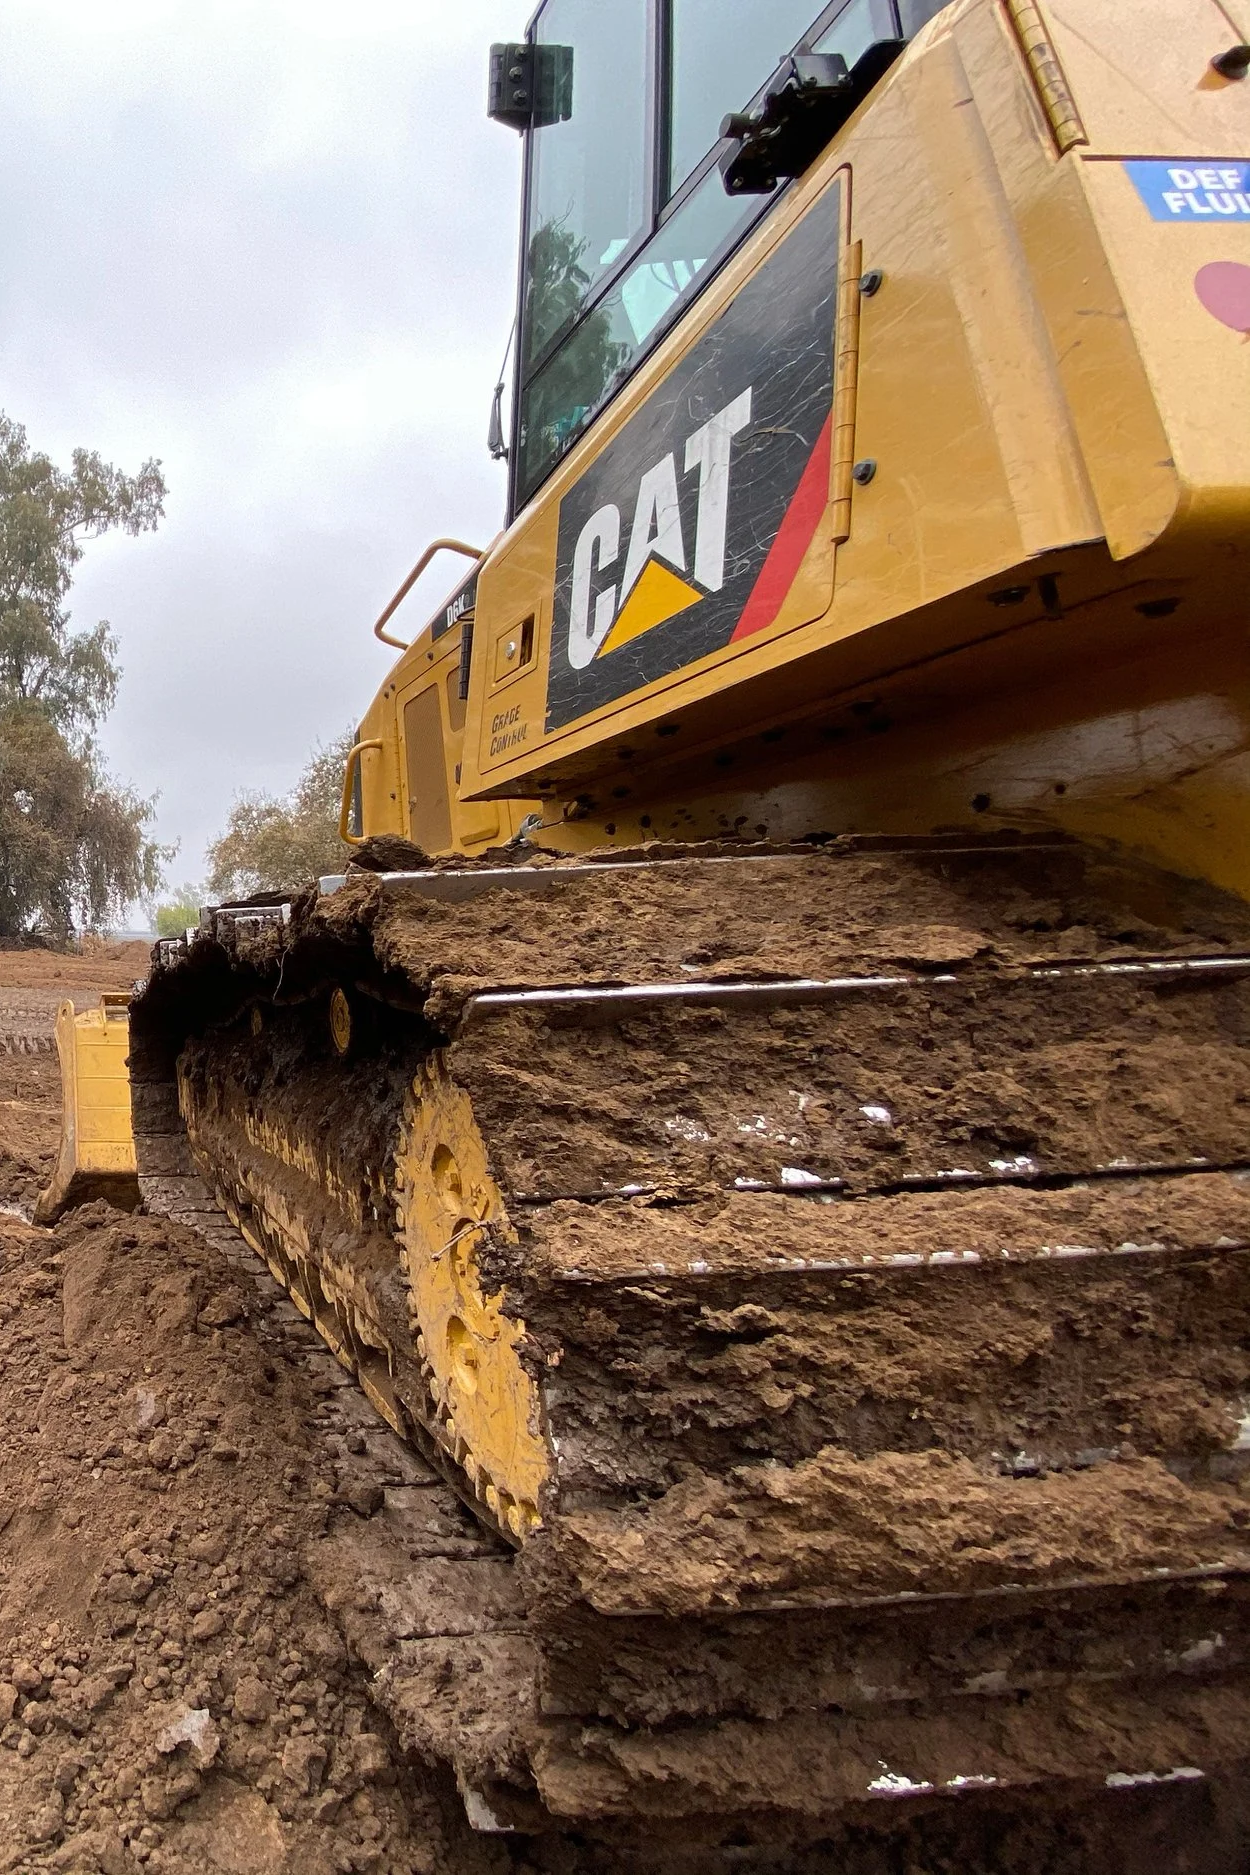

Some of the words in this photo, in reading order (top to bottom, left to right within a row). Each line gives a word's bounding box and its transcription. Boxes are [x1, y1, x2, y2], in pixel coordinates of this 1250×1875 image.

[1167, 168, 1241, 190] DEF
[1161, 192, 1250, 214] FLUI
[568, 386, 752, 670] CAT
